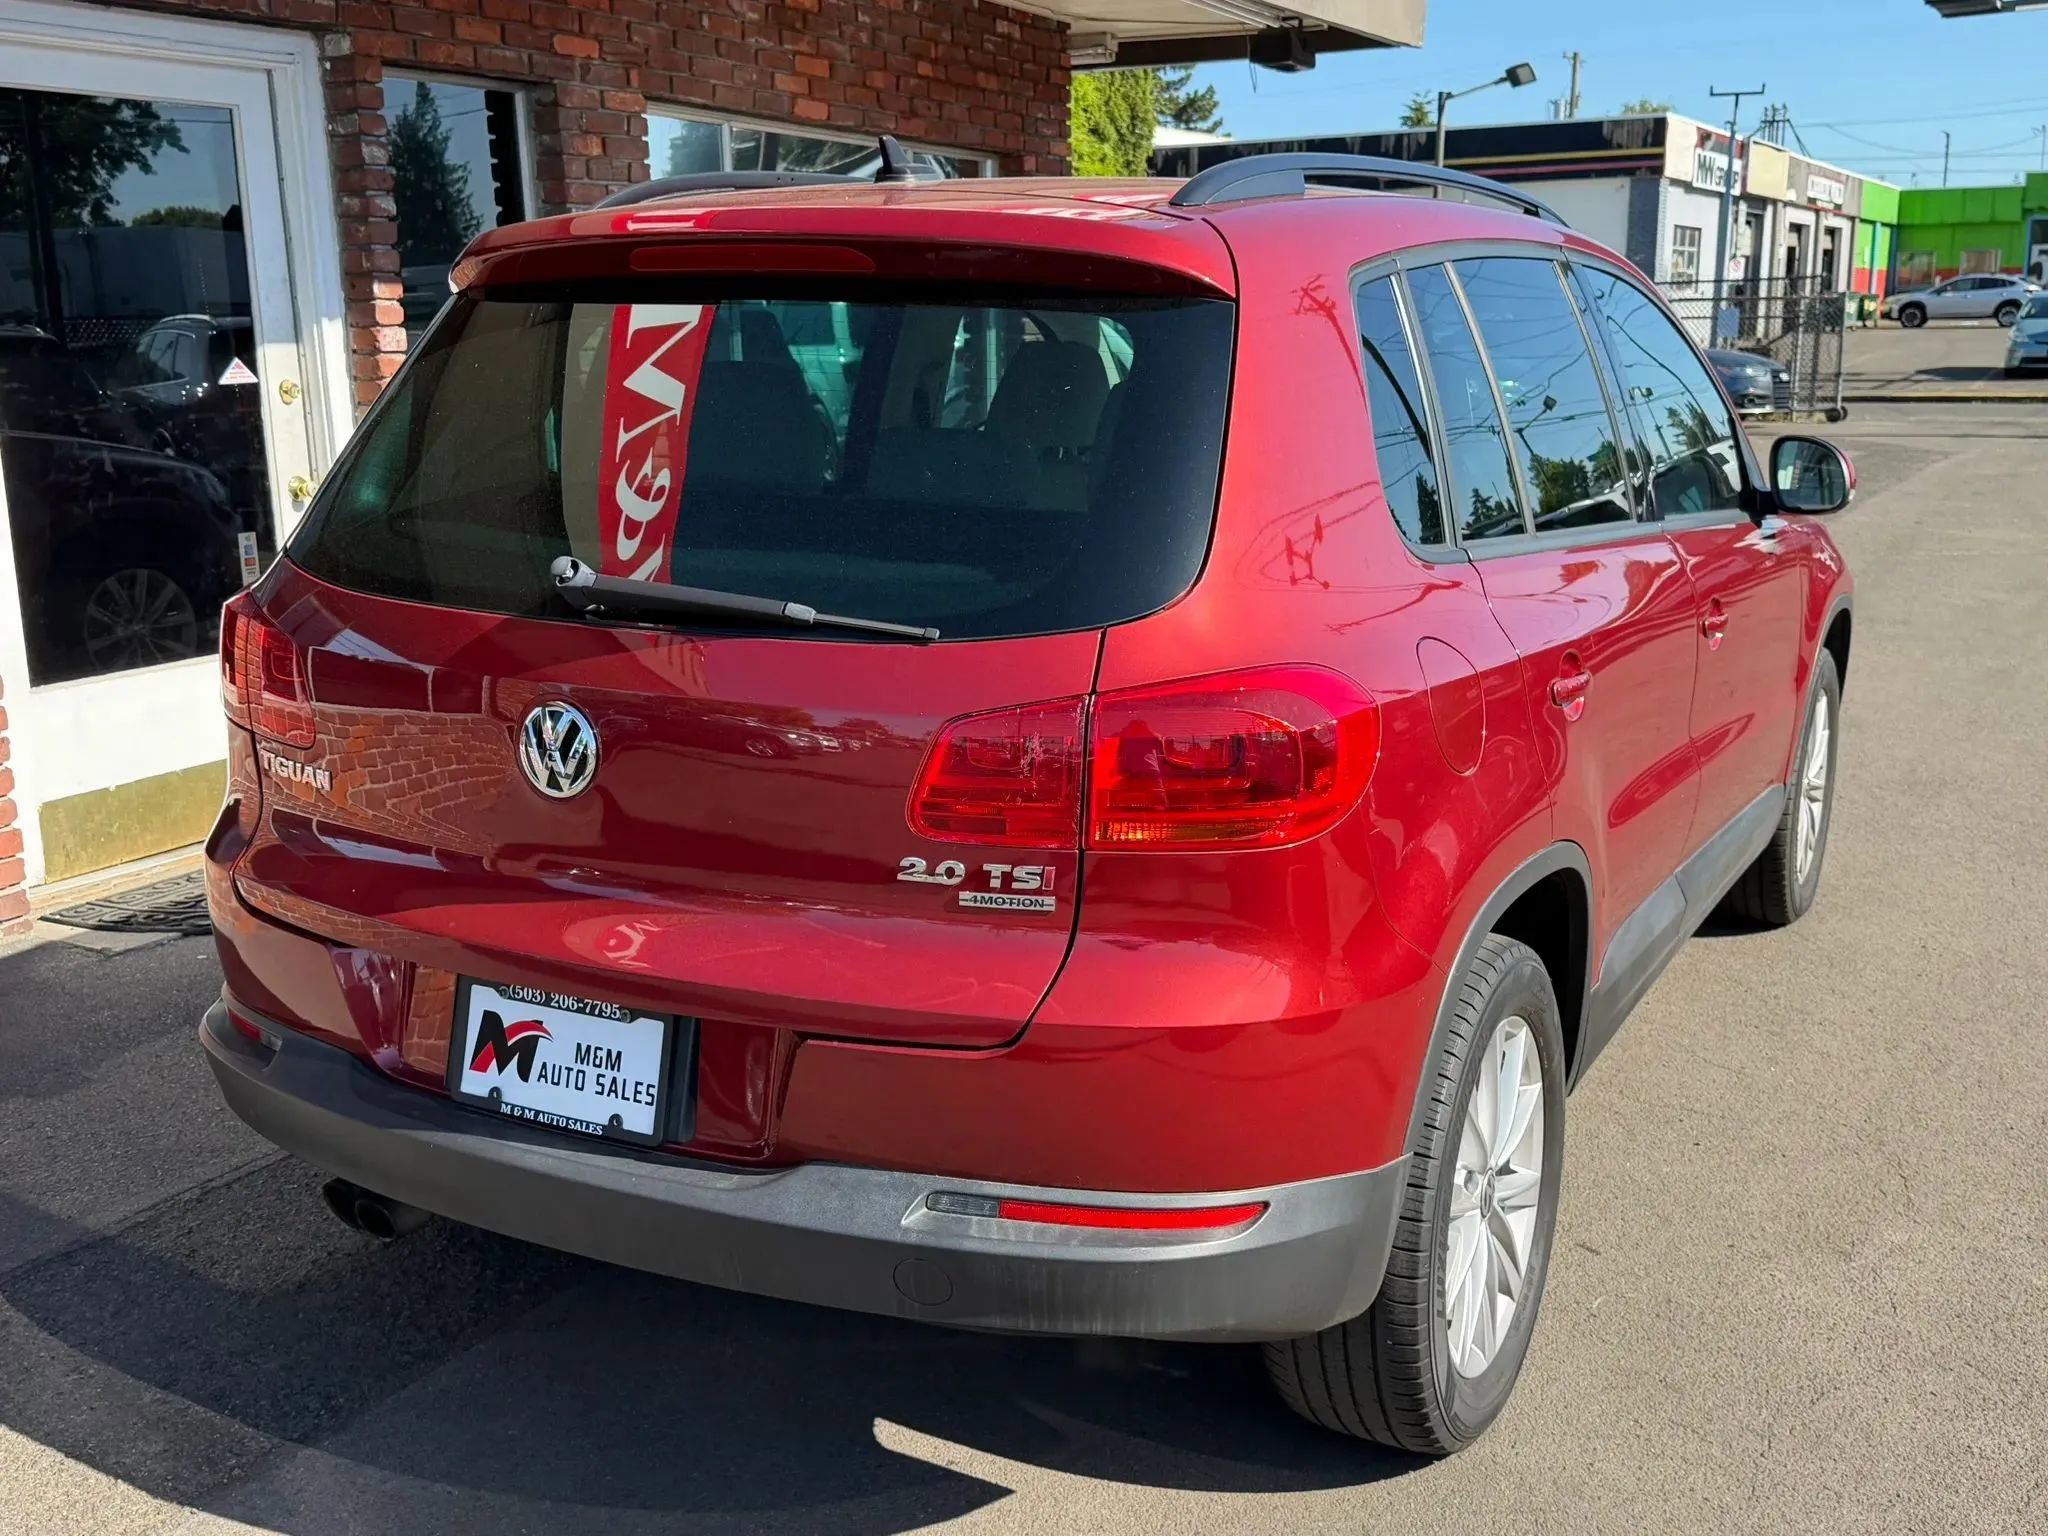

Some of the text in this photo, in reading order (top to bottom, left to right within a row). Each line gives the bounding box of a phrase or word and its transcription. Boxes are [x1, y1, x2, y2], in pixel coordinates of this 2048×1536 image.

[1714, 166, 1739, 190] GRP
[521, 702, 596, 797] VW
[260, 748, 331, 791] TIGUAN
[896, 856, 1056, 891] 2.0 TSI
[968, 894, 1046, 908] 4MOTION
[509, 983, 621, 1019] (503) 206-7795
[575, 1042, 622, 1072] M&M
[536, 1061, 656, 1106] AUTO SALES
[500, 1103, 512, 1114] M
[523, 1108, 536, 1120] M
[536, 1112, 567, 1127] AUTO
[567, 1118, 603, 1136] SALES
